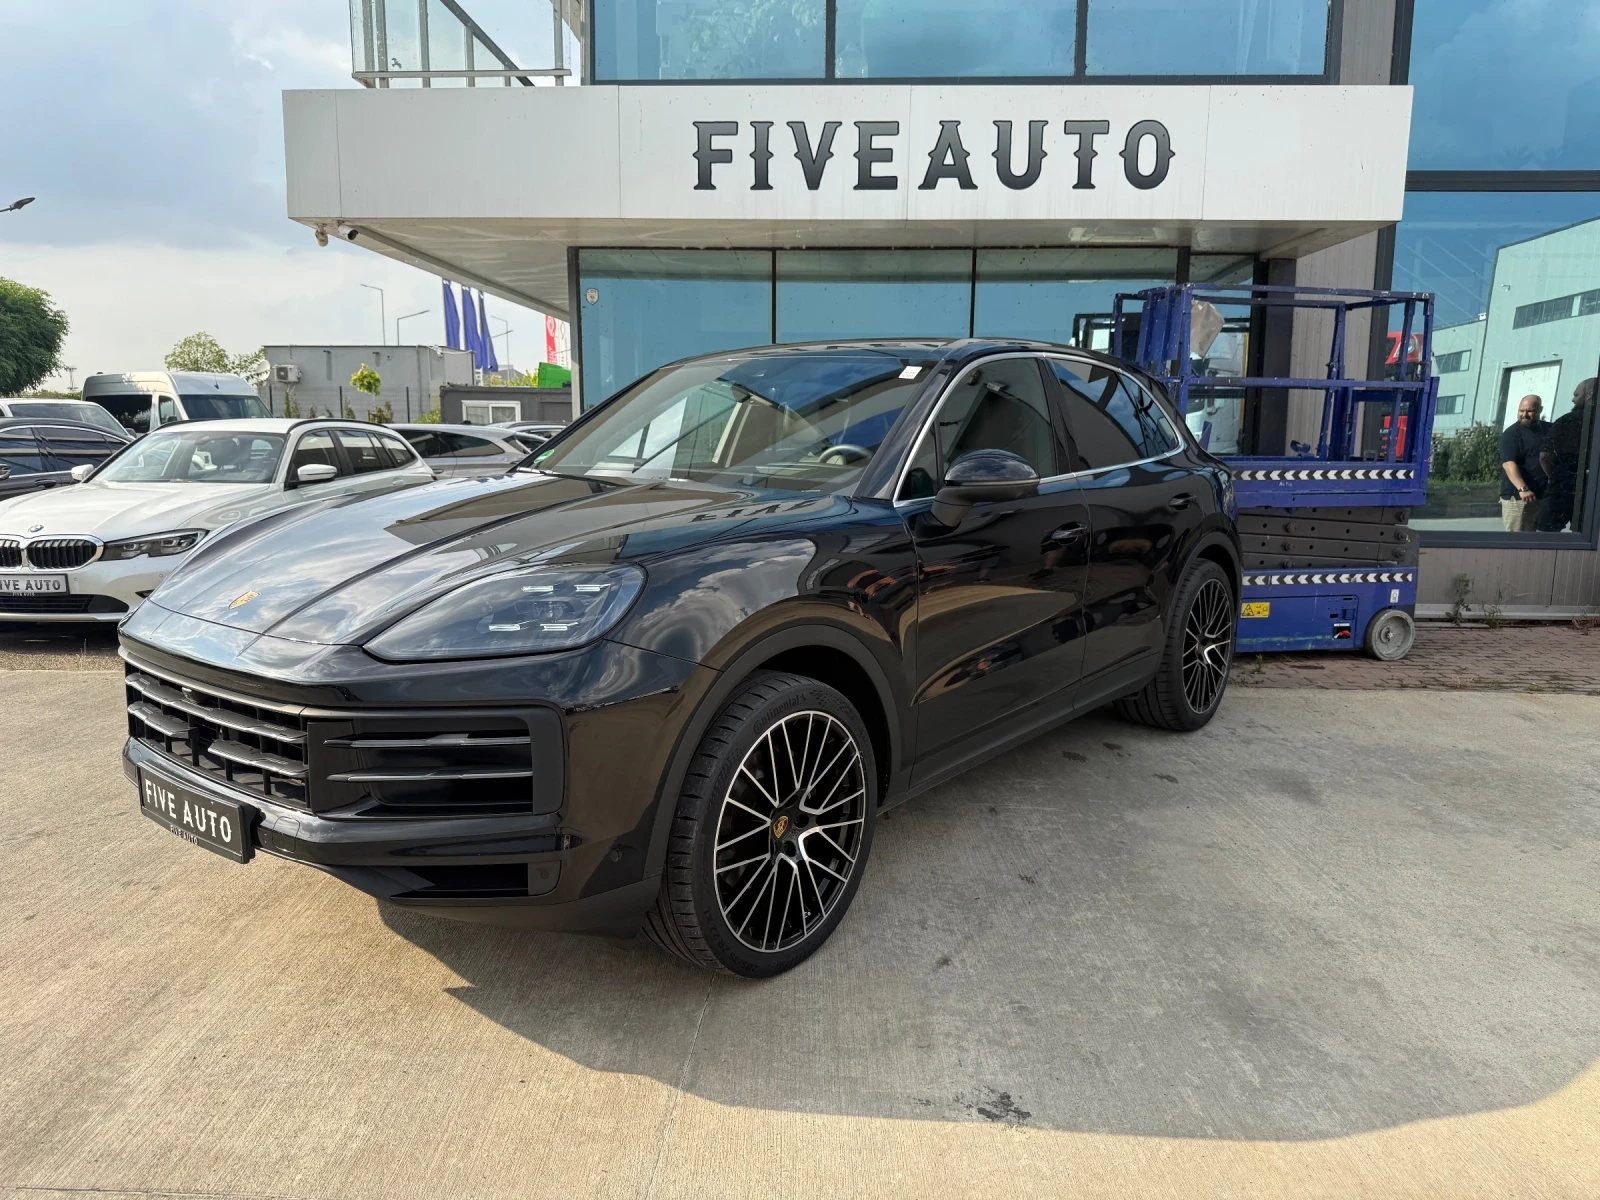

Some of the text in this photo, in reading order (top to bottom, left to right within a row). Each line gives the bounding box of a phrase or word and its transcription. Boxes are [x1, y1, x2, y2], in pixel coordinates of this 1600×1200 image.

[0, 579, 61, 590] IVE AUTO
[752, 694, 800, 736] Continental
[145, 778, 232, 843] FIVE AUTO
